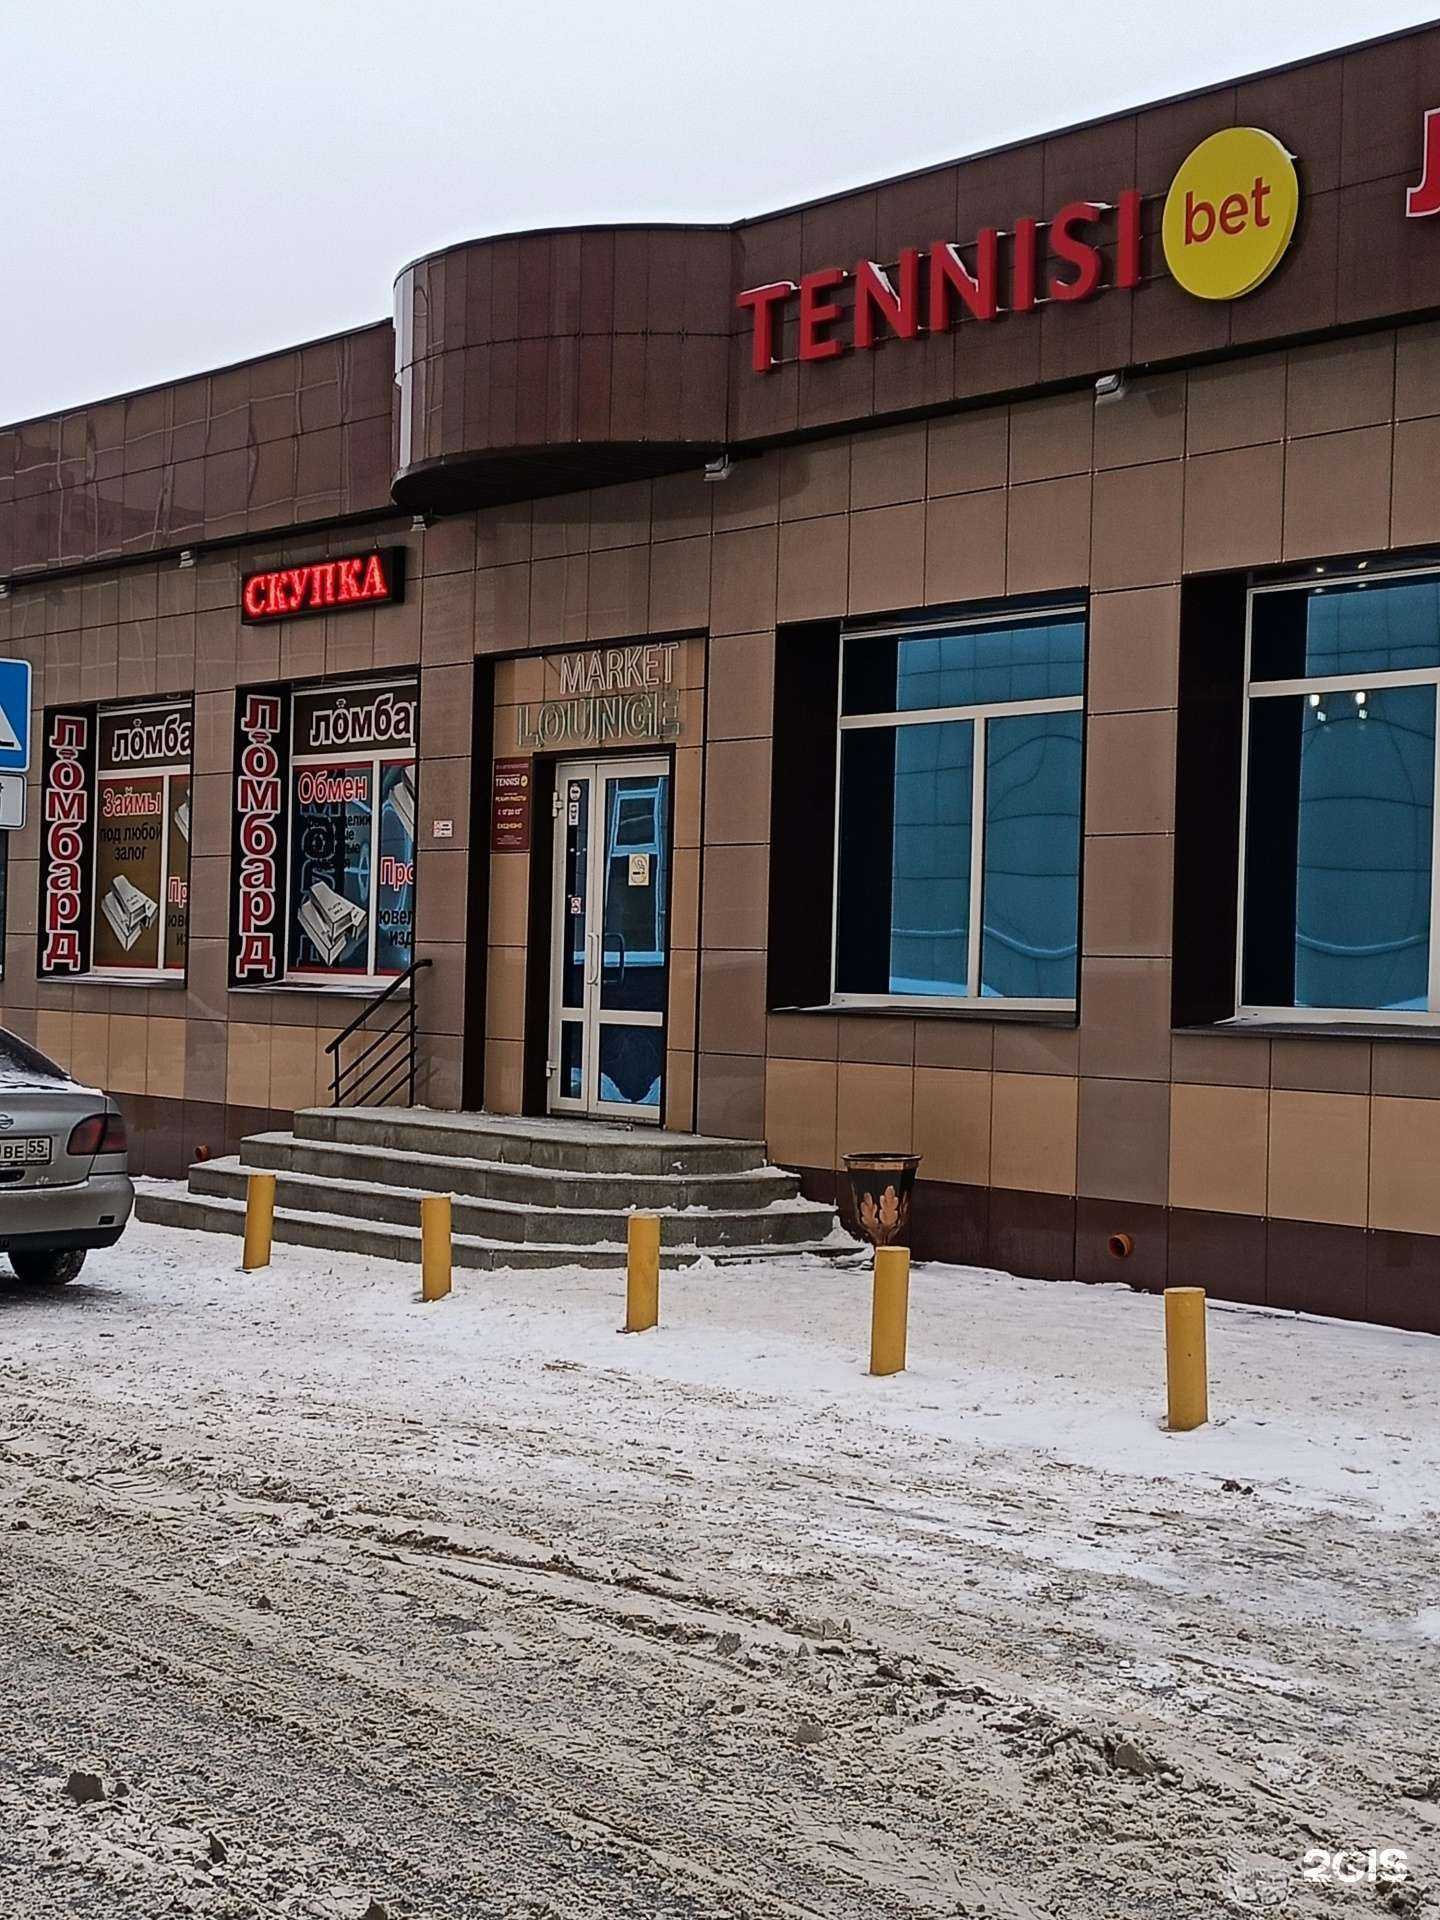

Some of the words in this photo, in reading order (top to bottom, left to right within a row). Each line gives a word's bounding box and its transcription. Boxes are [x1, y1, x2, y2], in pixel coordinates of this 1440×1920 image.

[737, 190, 1141, 373] TENNISI
[1184, 177, 1270, 245] bet
[244, 555, 388, 615] СКУПКА
[560, 642, 679, 694] MARKET
[517, 689, 681, 748] LOUNGE
[102, 787, 162, 817] Займы
[298, 771, 368, 804] Обмен
[113, 846, 147, 861] залог
[28, 1140, 45, 1153] 55
